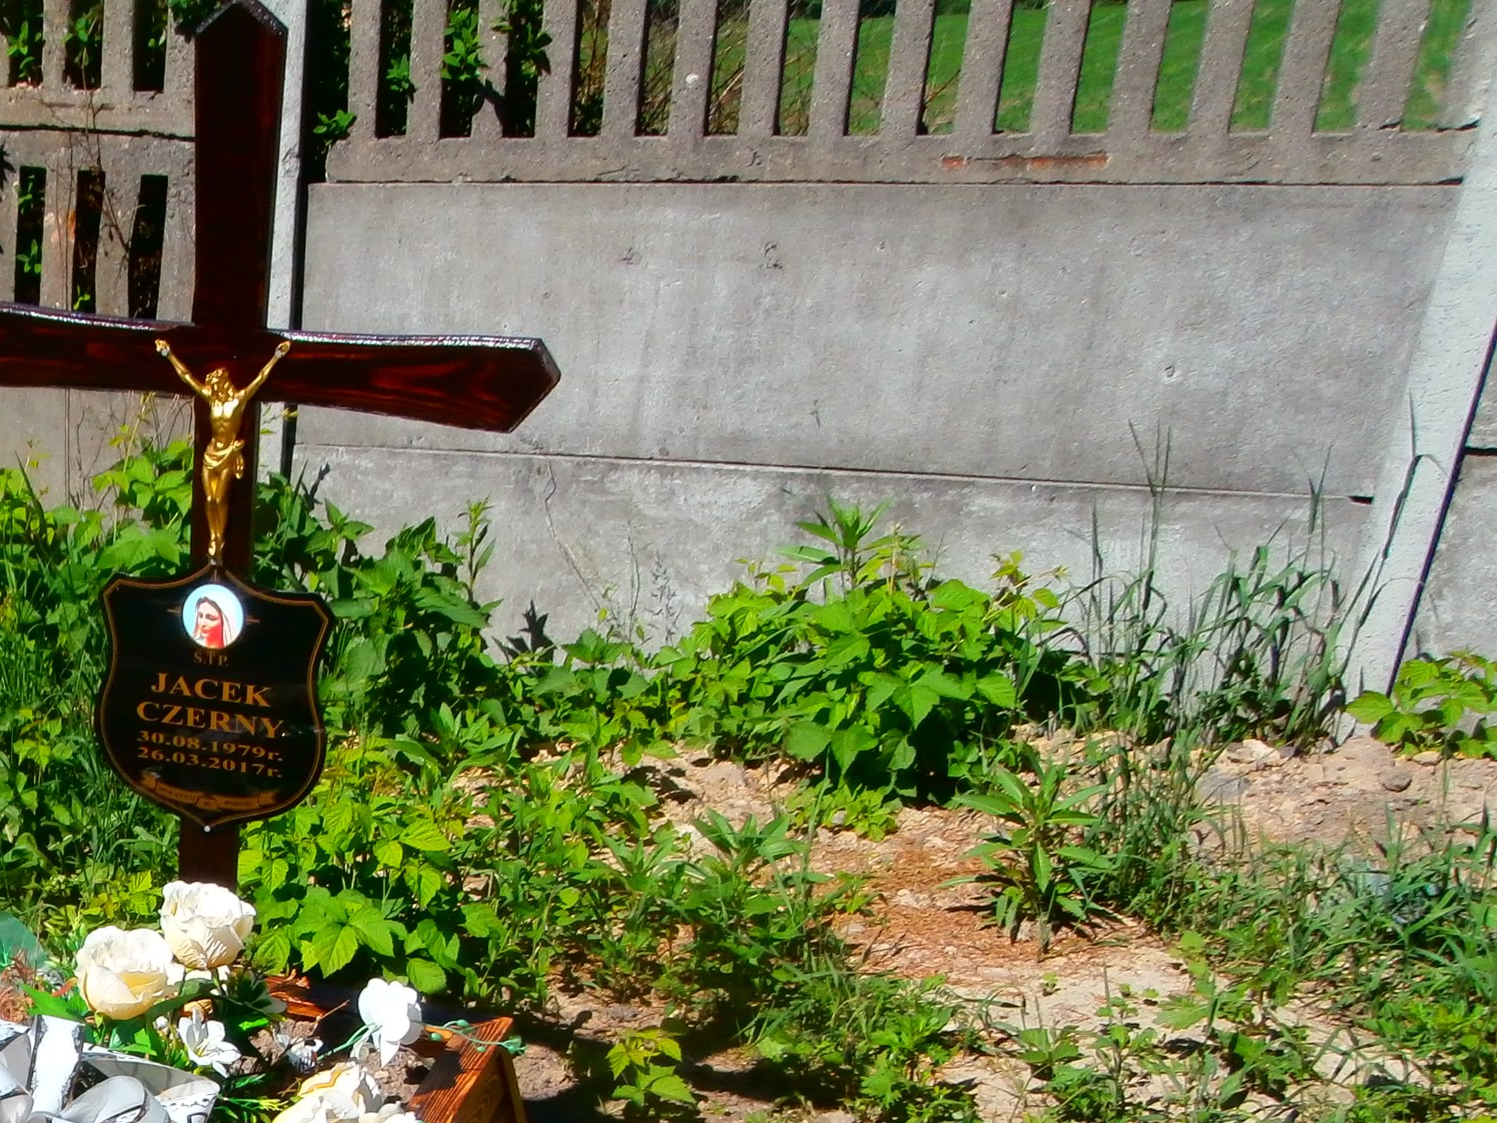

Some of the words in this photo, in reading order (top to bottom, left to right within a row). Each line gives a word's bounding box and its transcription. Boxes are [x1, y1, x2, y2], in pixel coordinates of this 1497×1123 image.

[151, 672, 271, 708] JACEK
[136, 701, 284, 738] CZERNY
[137, 730, 283, 762] 30.08.1979r.
[137, 746, 283, 778] 26.03.2017r.
